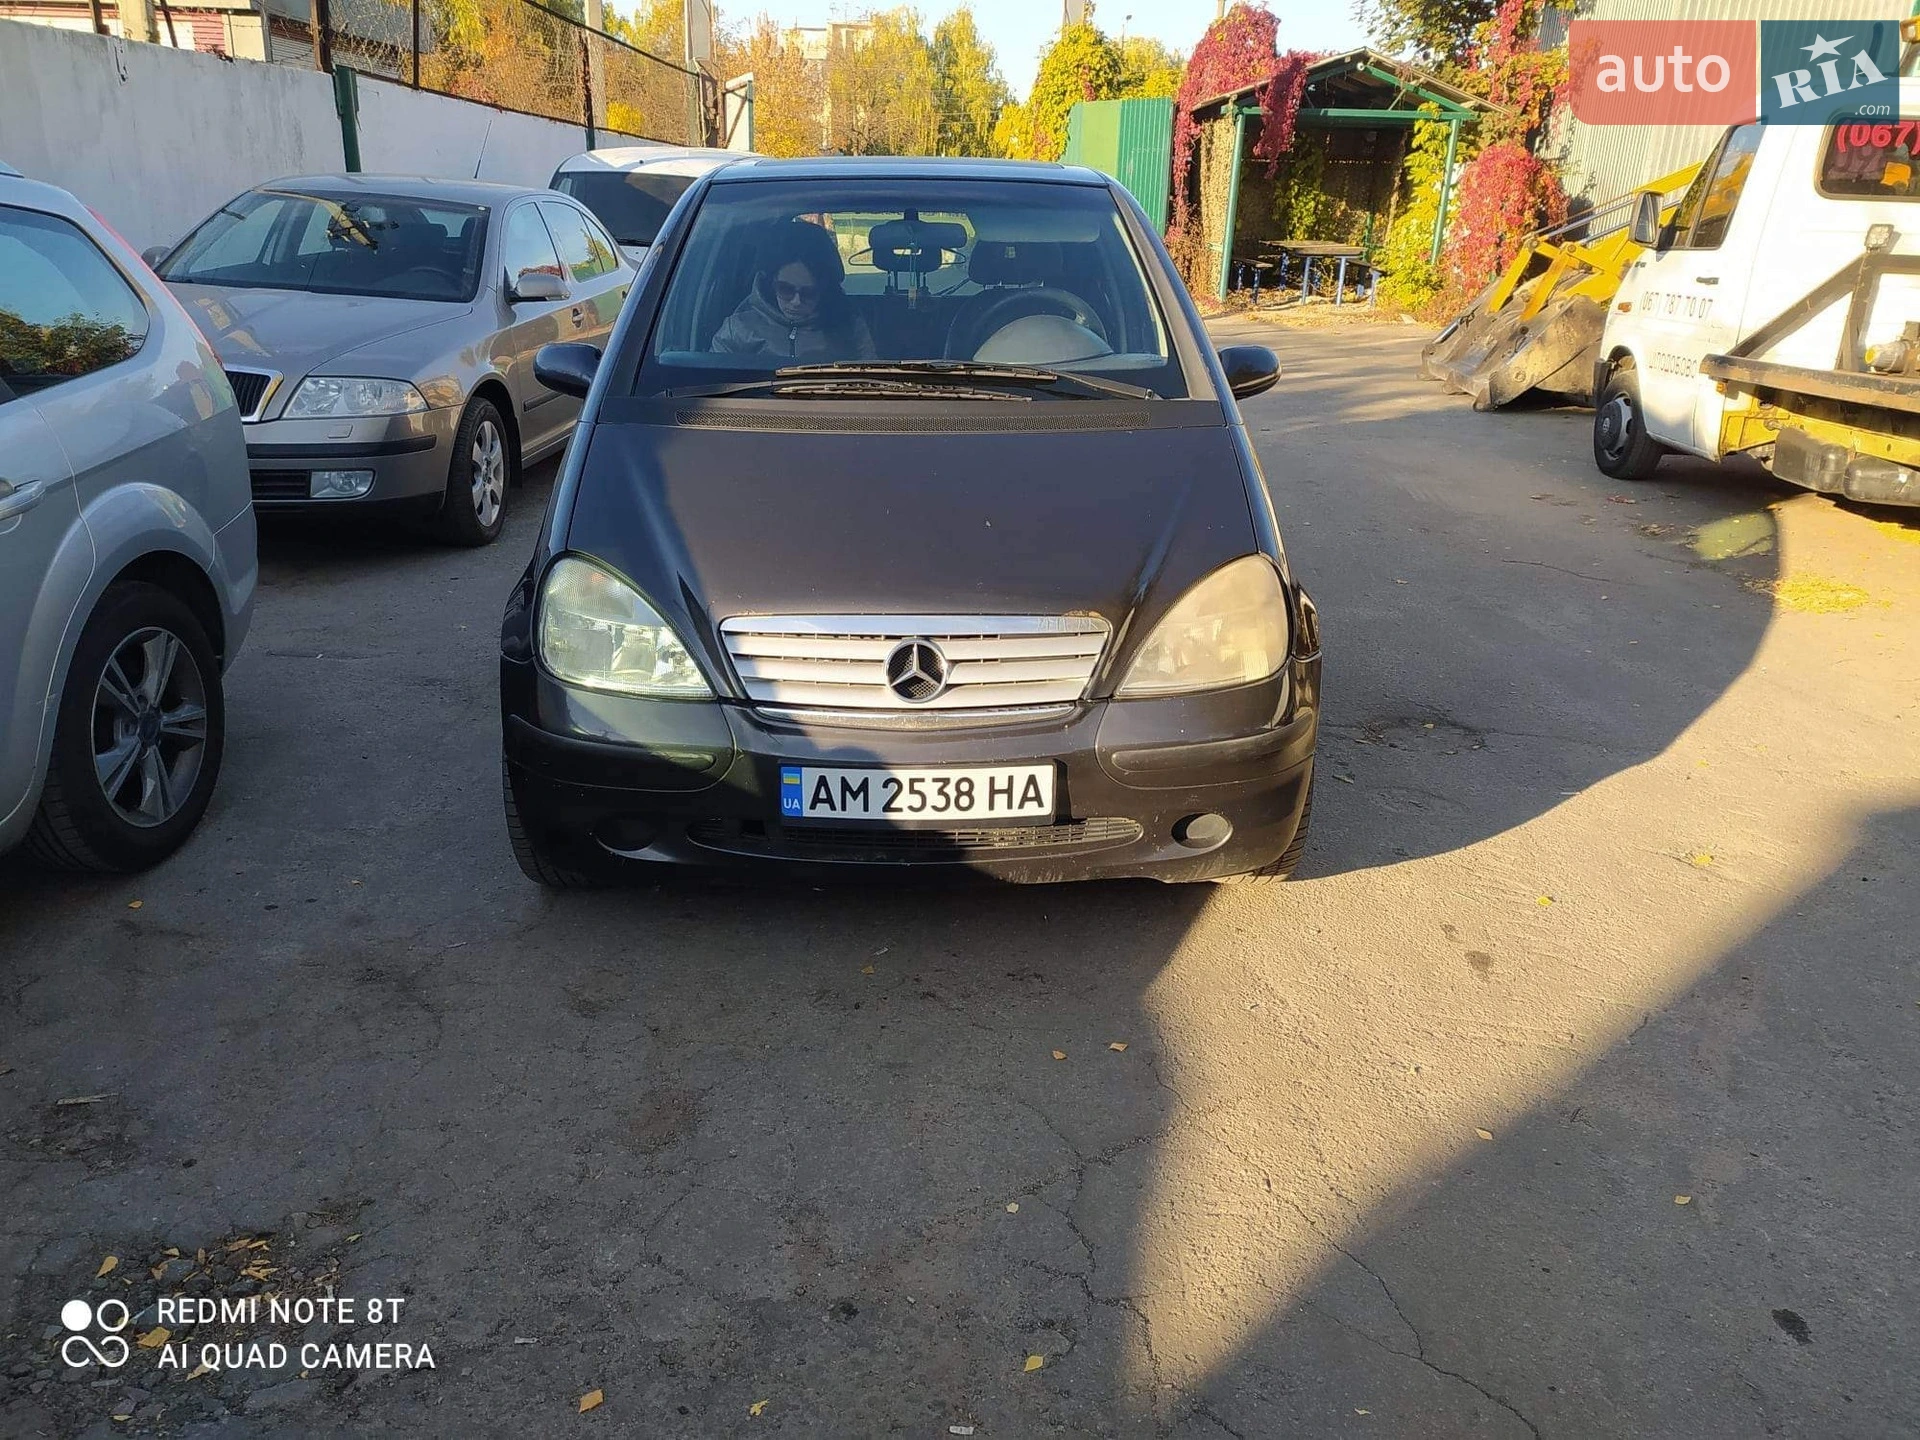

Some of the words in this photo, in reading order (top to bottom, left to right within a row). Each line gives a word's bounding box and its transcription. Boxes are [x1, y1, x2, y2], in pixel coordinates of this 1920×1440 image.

[783, 798, 801, 810] UA
[809, 775, 870, 812] AM
[881, 777, 975, 812] 2538
[988, 774, 1045, 811] HA
